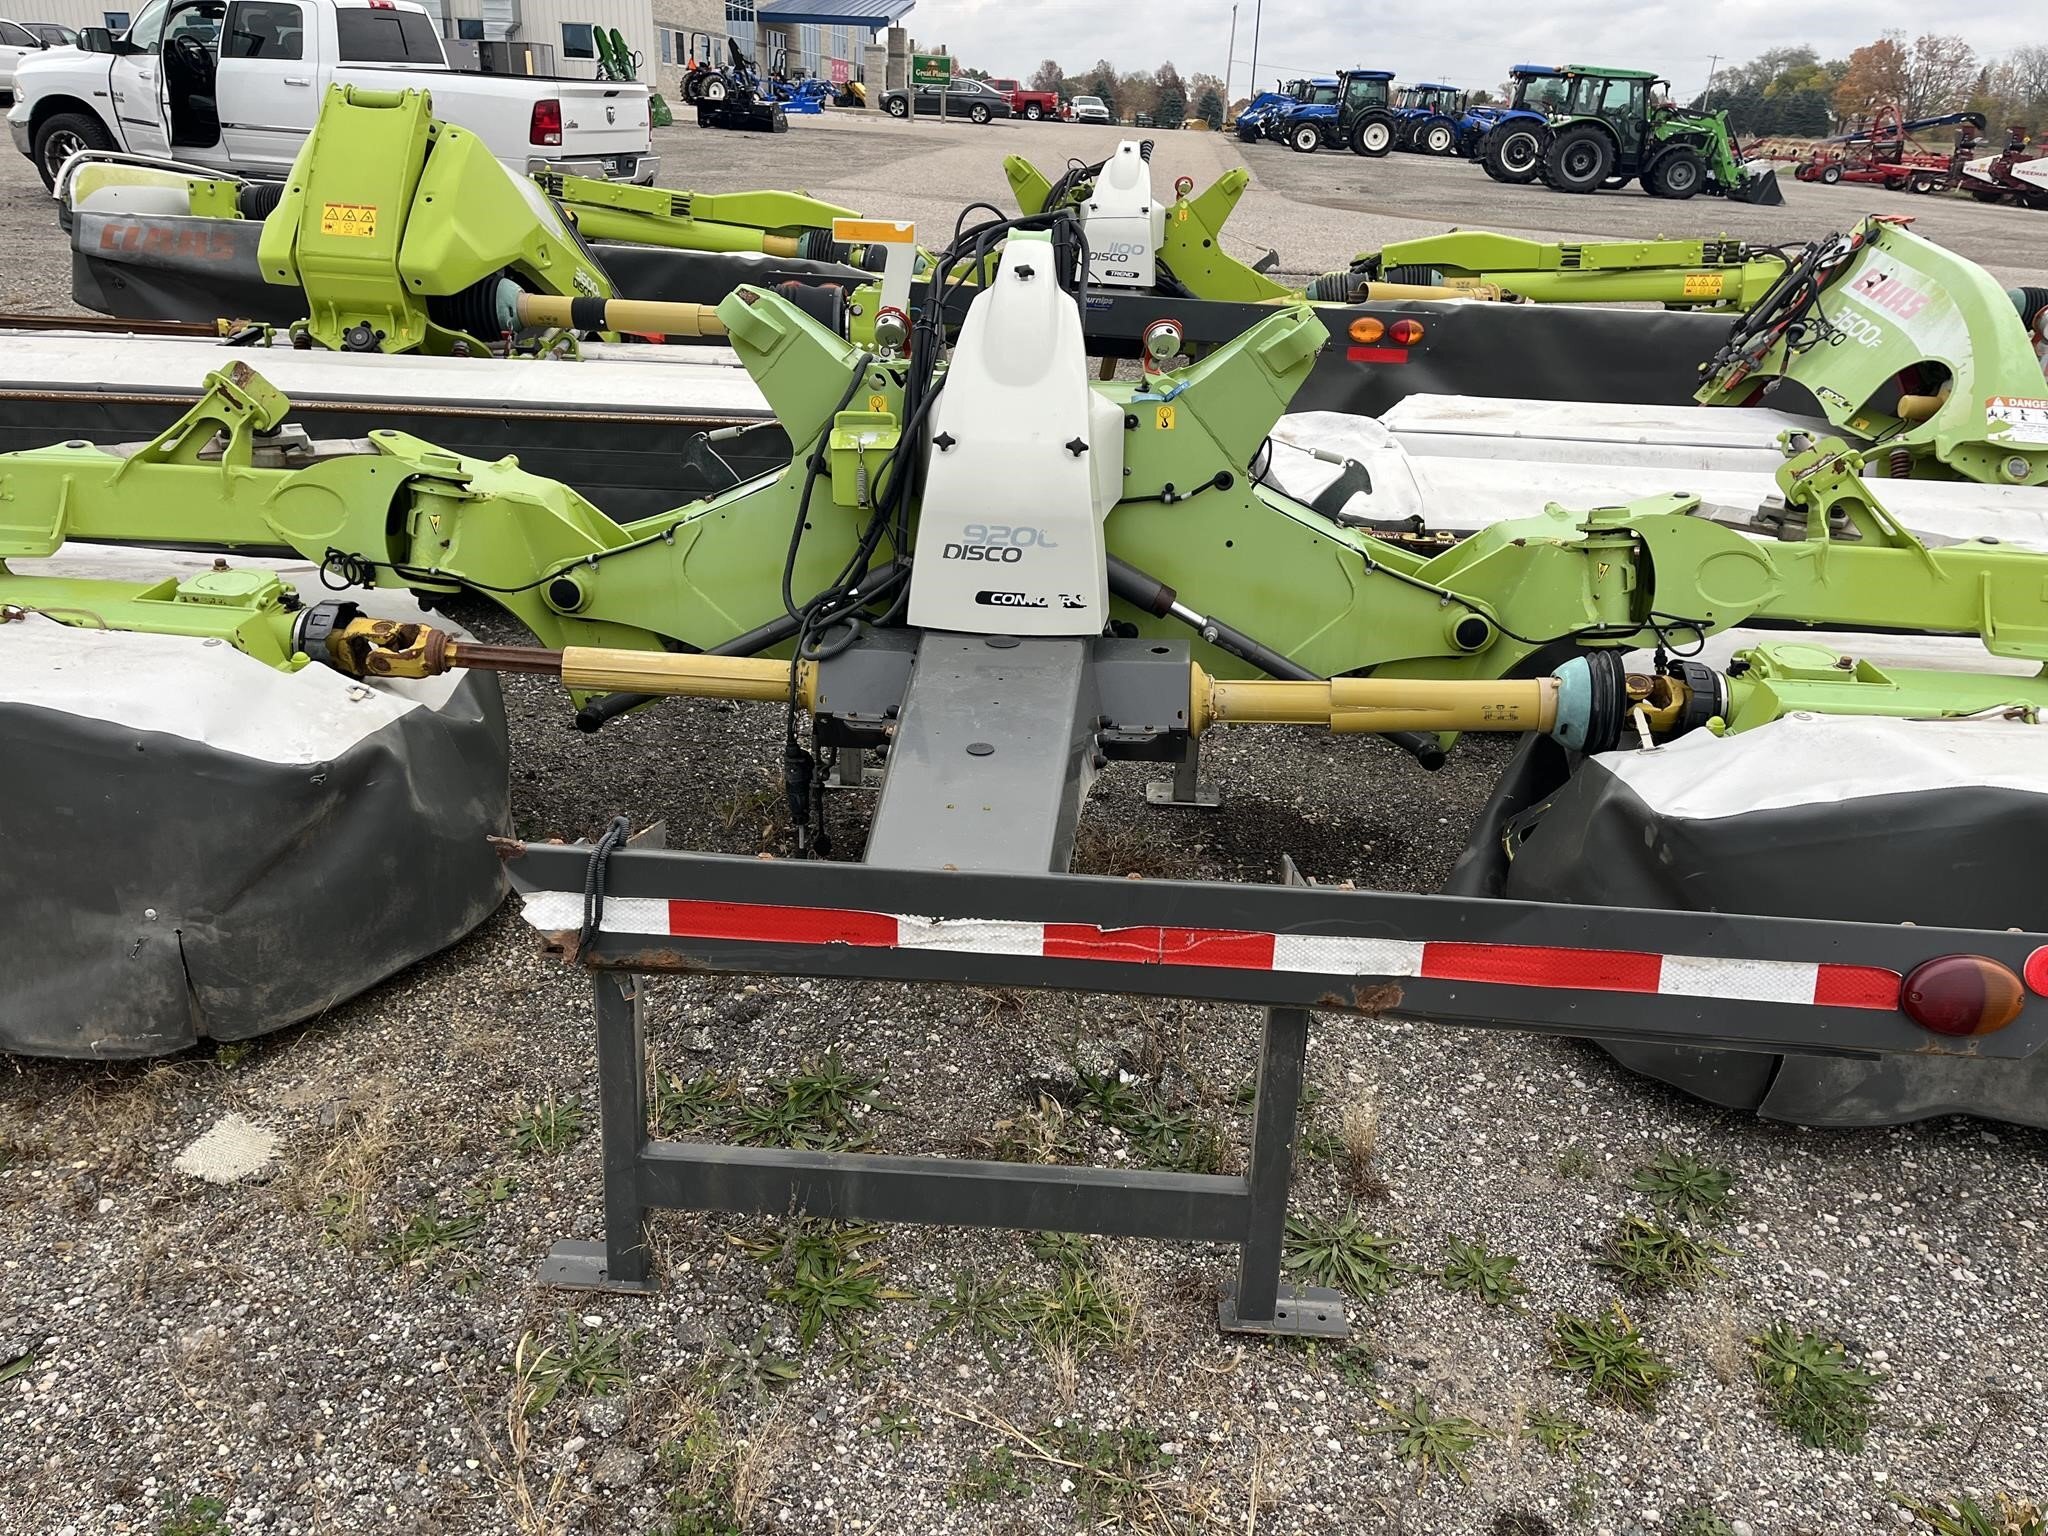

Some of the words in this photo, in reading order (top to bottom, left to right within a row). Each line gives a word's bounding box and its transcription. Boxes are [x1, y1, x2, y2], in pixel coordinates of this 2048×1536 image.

[99, 223, 237, 261] CLAAS
[1108, 242, 1145, 256] 1100
[1110, 270, 1135, 278] TREND
[2008, 398, 2048, 409] DANGE
[942, 543, 1023, 563] DISCO
